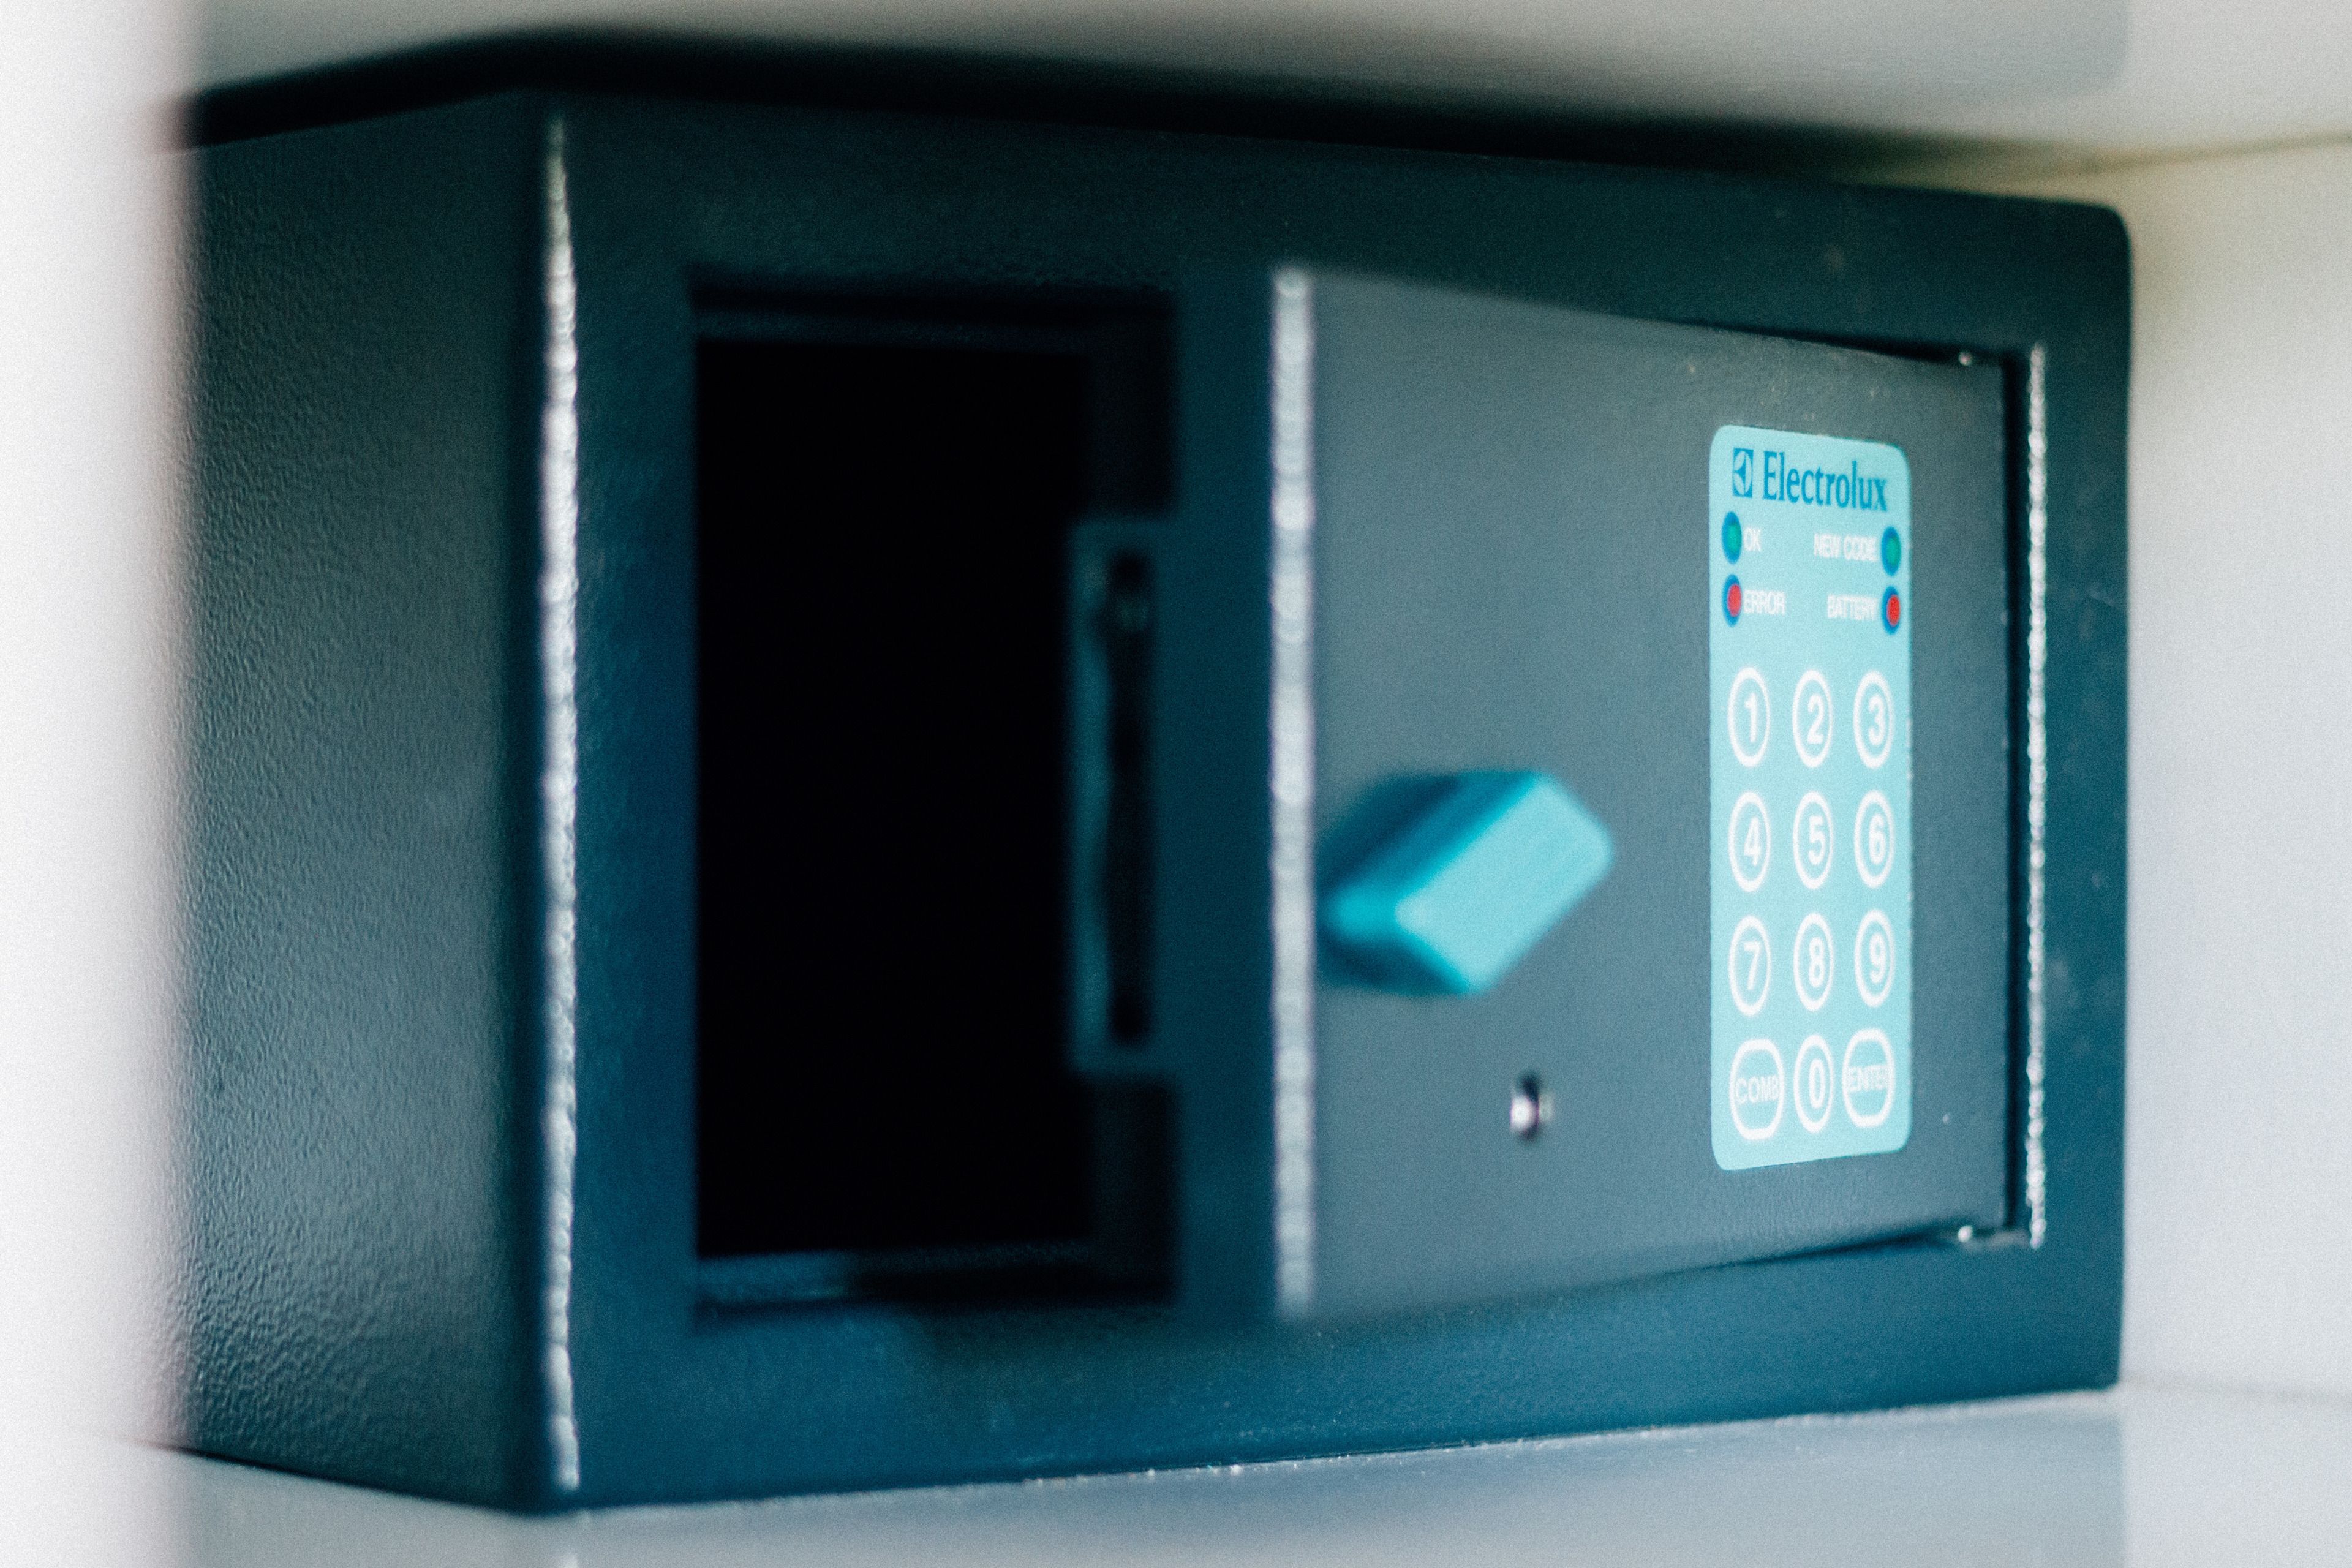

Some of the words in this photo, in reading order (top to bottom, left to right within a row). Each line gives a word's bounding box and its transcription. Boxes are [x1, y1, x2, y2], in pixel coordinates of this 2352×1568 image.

[1763, 450, 1888, 512] Electrolux
[1743, 527, 1762, 552] OK
[1814, 532, 1841, 559] NEW
[1844, 534, 1878, 563] CODE
[1744, 589, 1786, 615] ERROR
[1827, 594, 1879, 621] BATTERY
[1744, 692, 1757, 744] 1
[1807, 693, 1825, 745] 2
[1868, 695, 1886, 746] 3
[1743, 816, 1762, 867] 4
[1807, 815, 1826, 866] 5
[1868, 813, 1887, 865] 6
[1743, 941, 1761, 991] 7
[1808, 936, 1826, 988] 8
[1869, 932, 1887, 984] 9
[1809, 1058, 1826, 1109] 0
